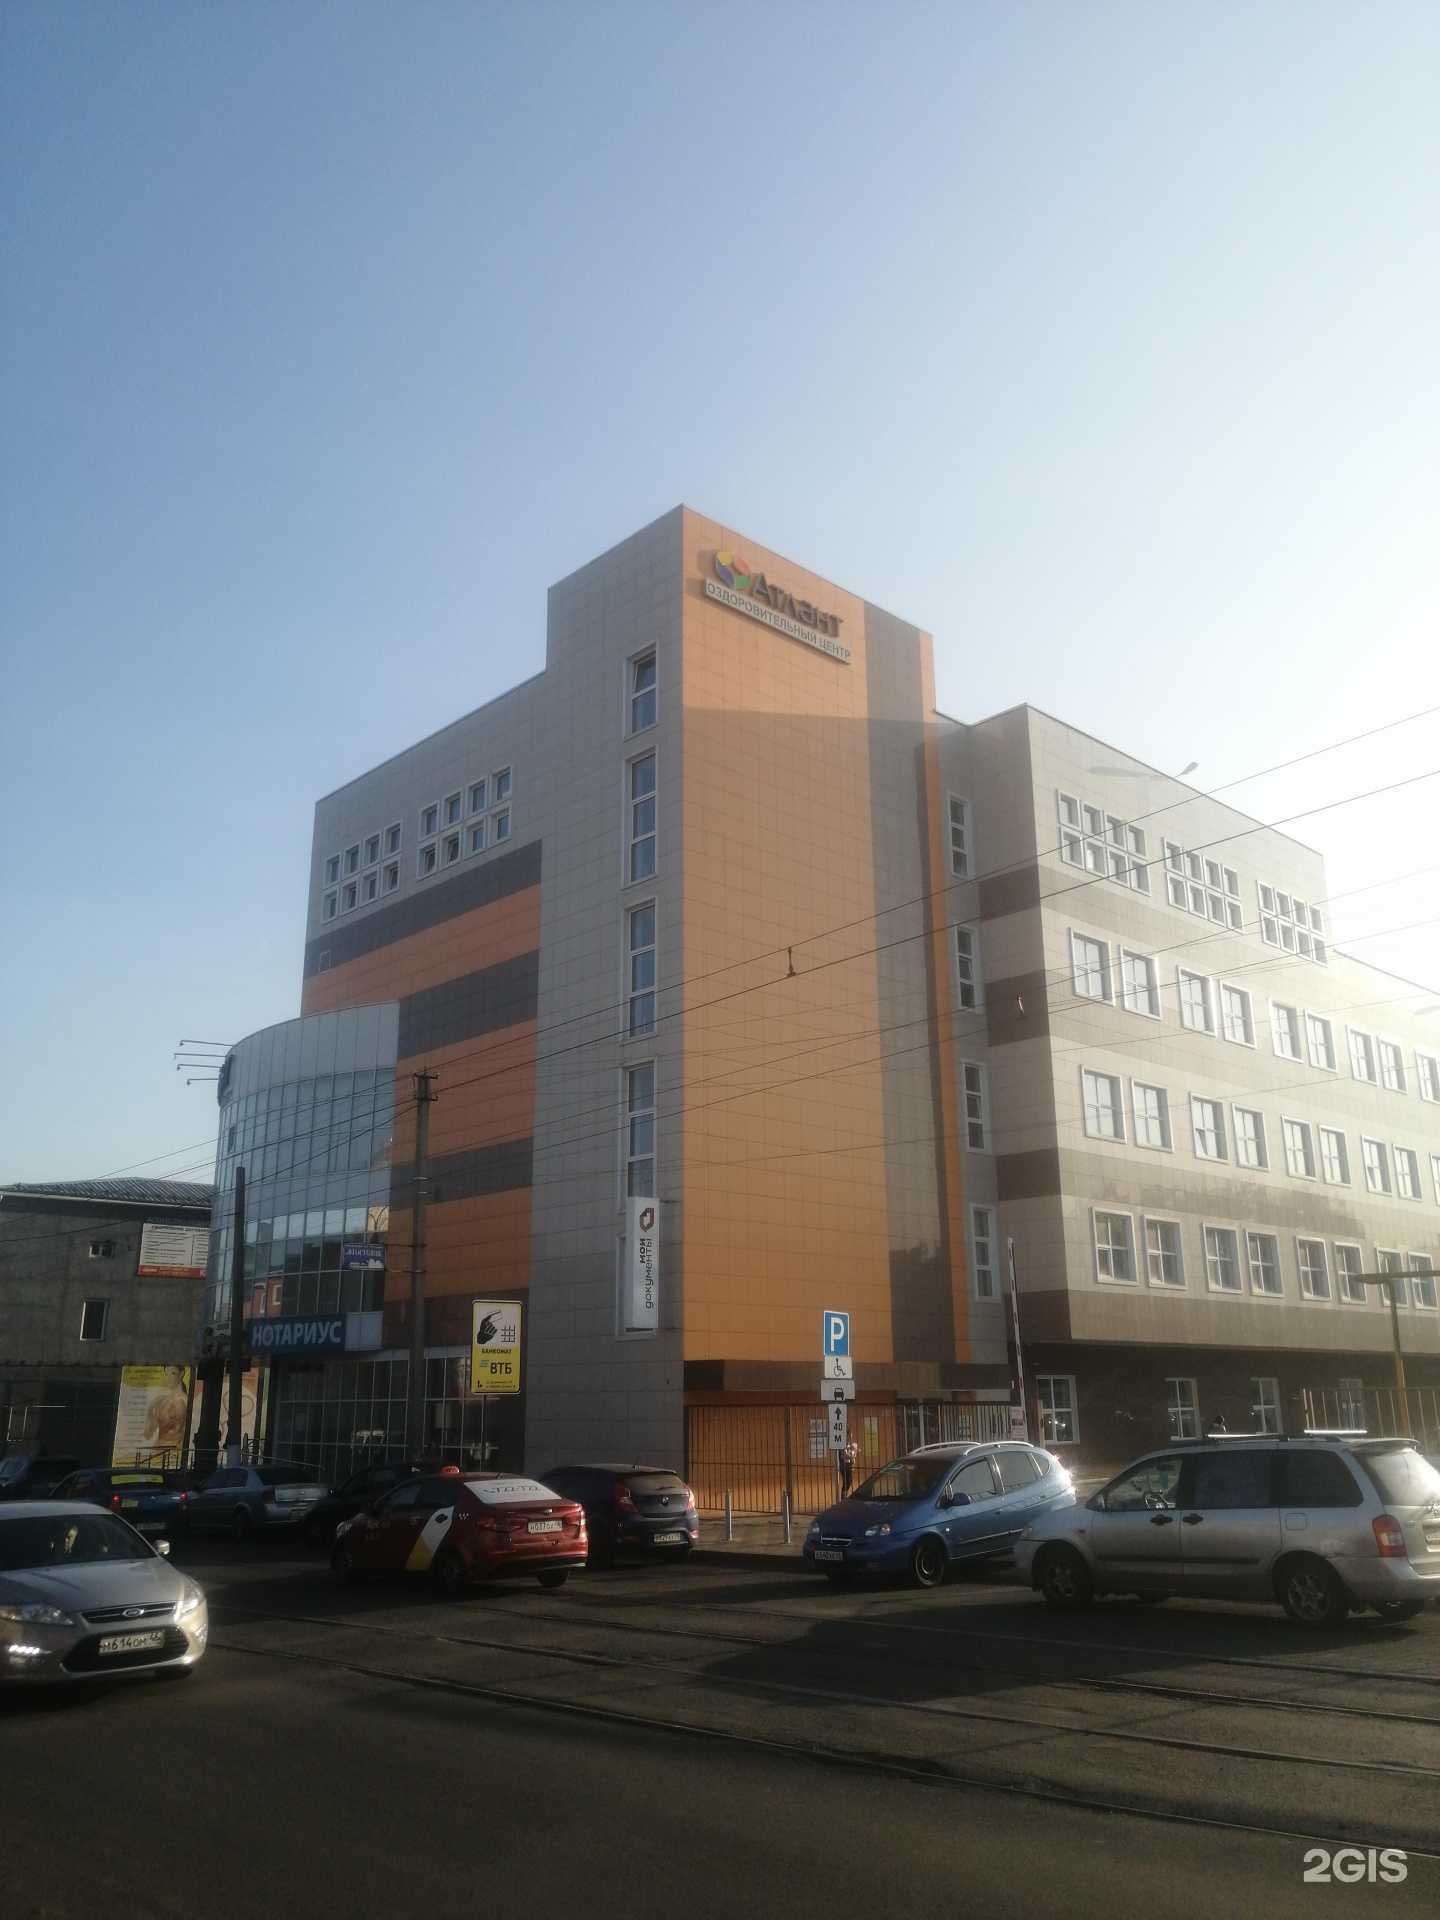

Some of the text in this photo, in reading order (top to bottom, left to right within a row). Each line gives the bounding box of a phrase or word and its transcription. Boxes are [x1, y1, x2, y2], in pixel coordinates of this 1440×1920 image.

[707, 581, 850, 659] ОЗДОРОВИТЕЛЬНЫЙ ЦЕНТР
[251, 1321, 342, 1348] НОТАРИУС
[830, 1317, 845, 1352] P
[490, 1362, 512, 1375] ВТБ
[833, 1422, 843, 1431] 40
